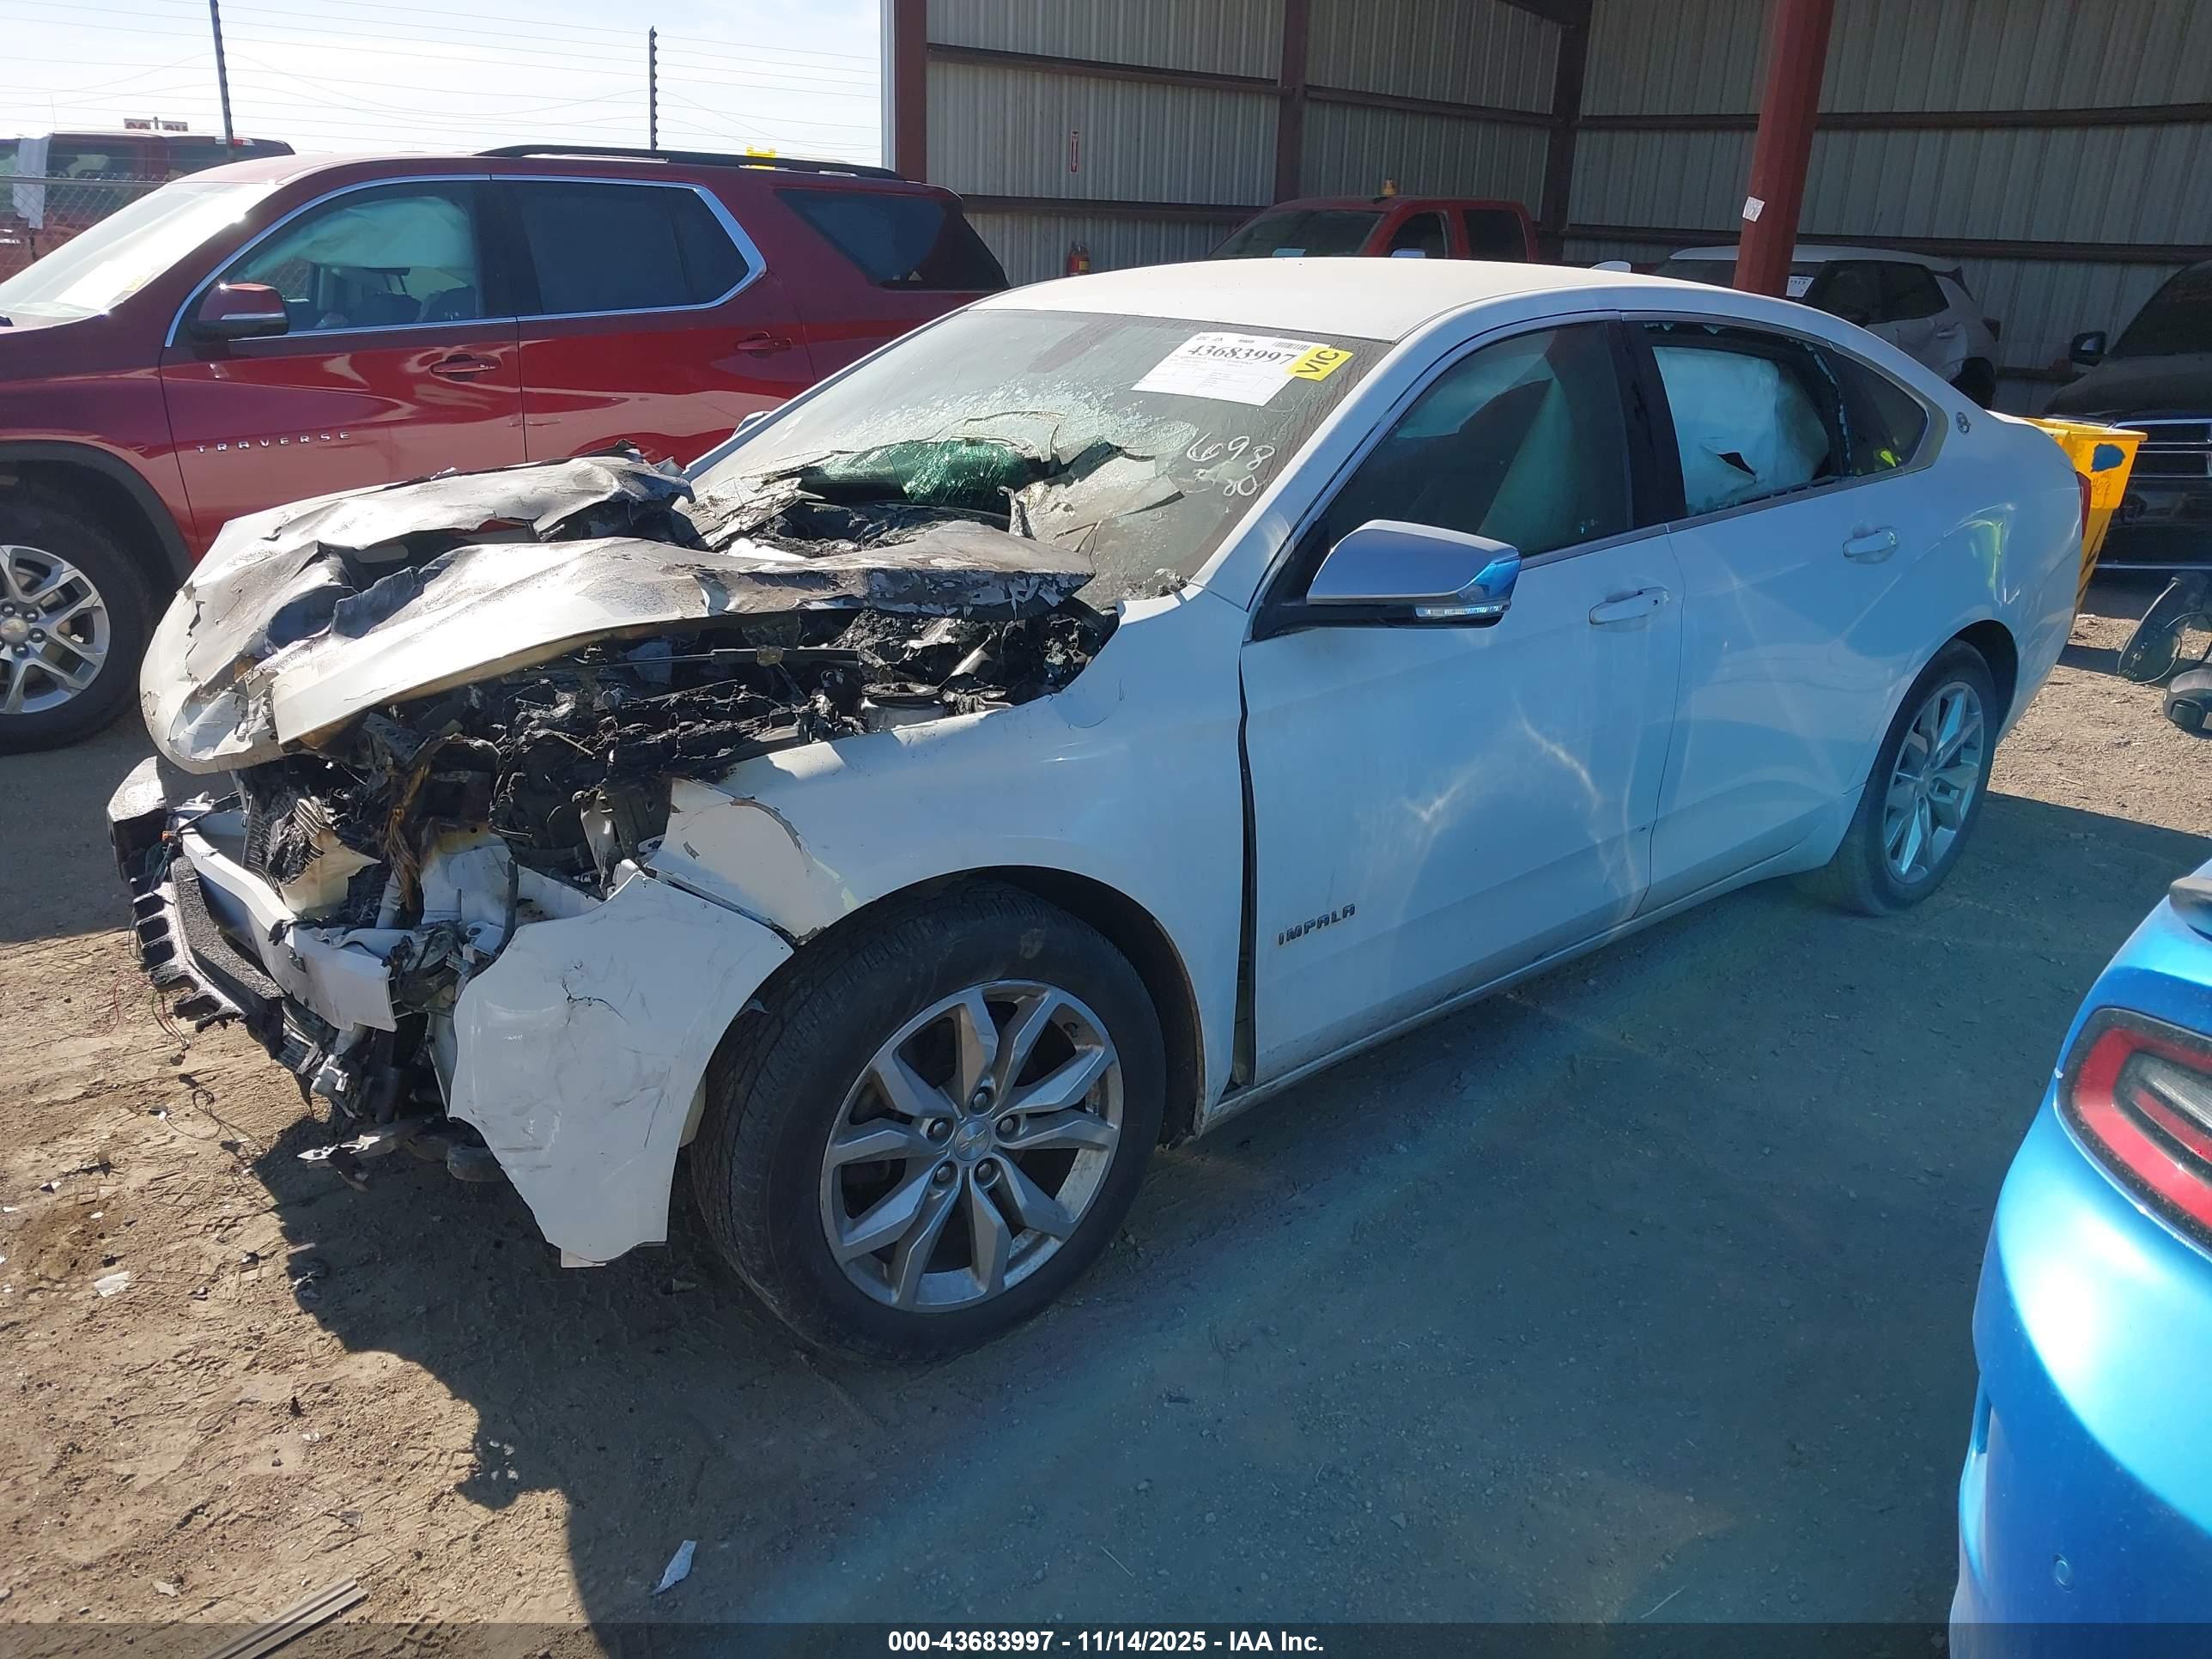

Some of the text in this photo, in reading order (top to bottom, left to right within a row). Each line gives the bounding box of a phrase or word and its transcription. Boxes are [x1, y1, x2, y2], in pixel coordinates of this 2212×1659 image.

[1188, 343, 1298, 365] 43683997
[1295, 349, 1340, 375] VIC
[196, 431, 350, 453] TRAVERSE
[1278, 903, 1356, 945] IMPALA
